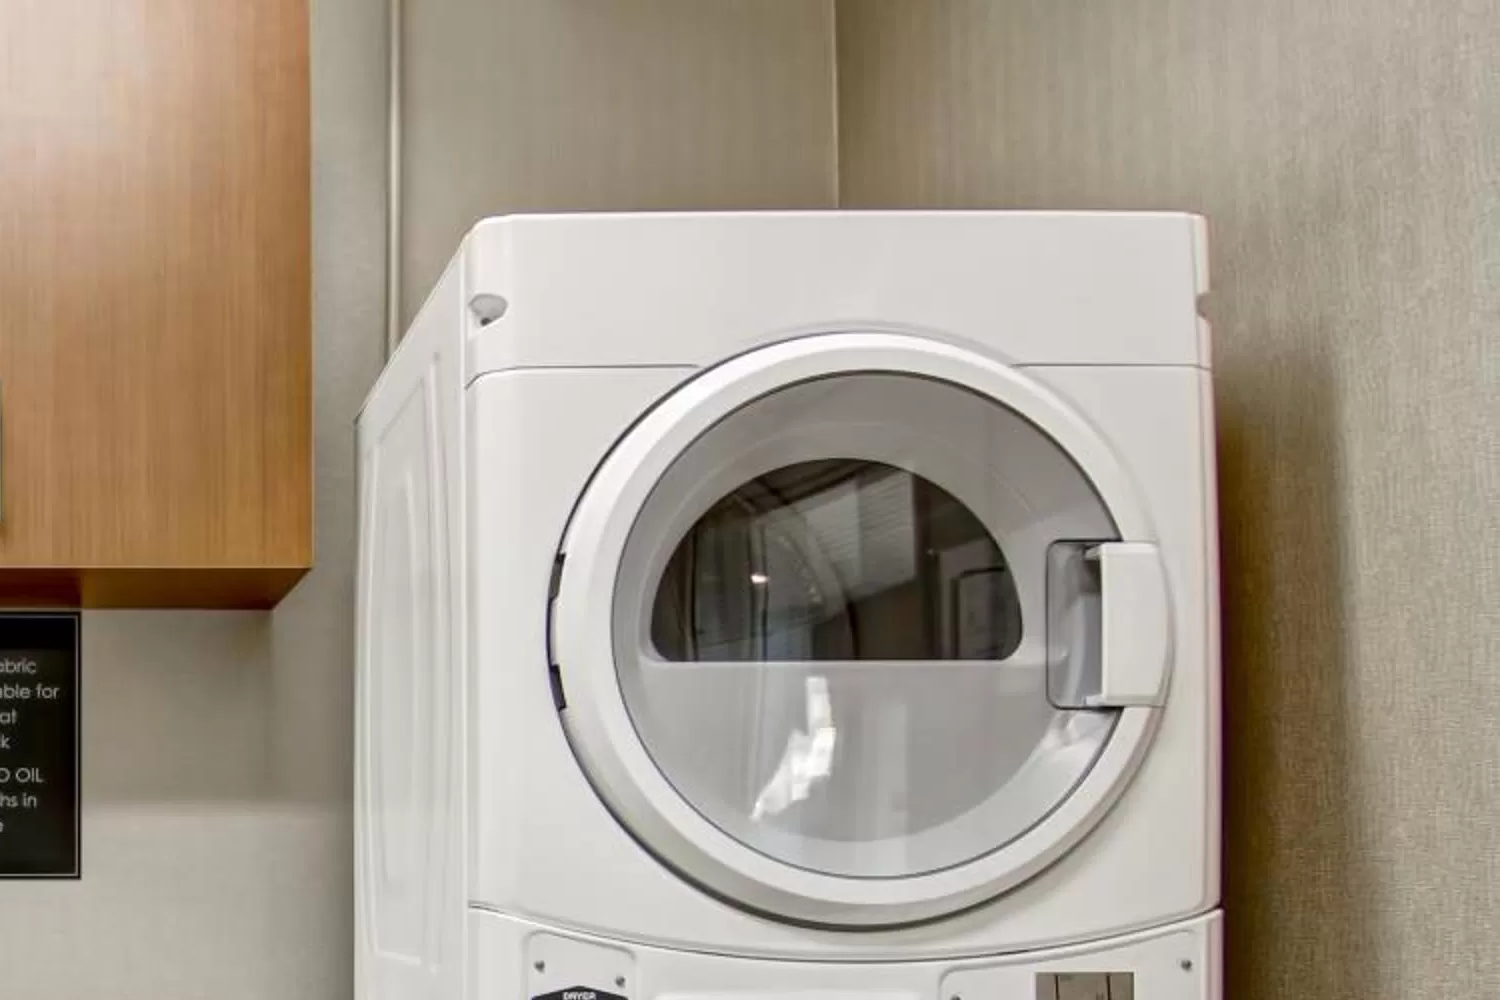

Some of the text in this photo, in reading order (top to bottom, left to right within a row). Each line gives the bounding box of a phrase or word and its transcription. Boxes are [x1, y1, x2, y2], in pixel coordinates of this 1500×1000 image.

[36, 683, 60, 700] for
[15, 767, 45, 783] OIL
[22, 792, 38, 808] in
